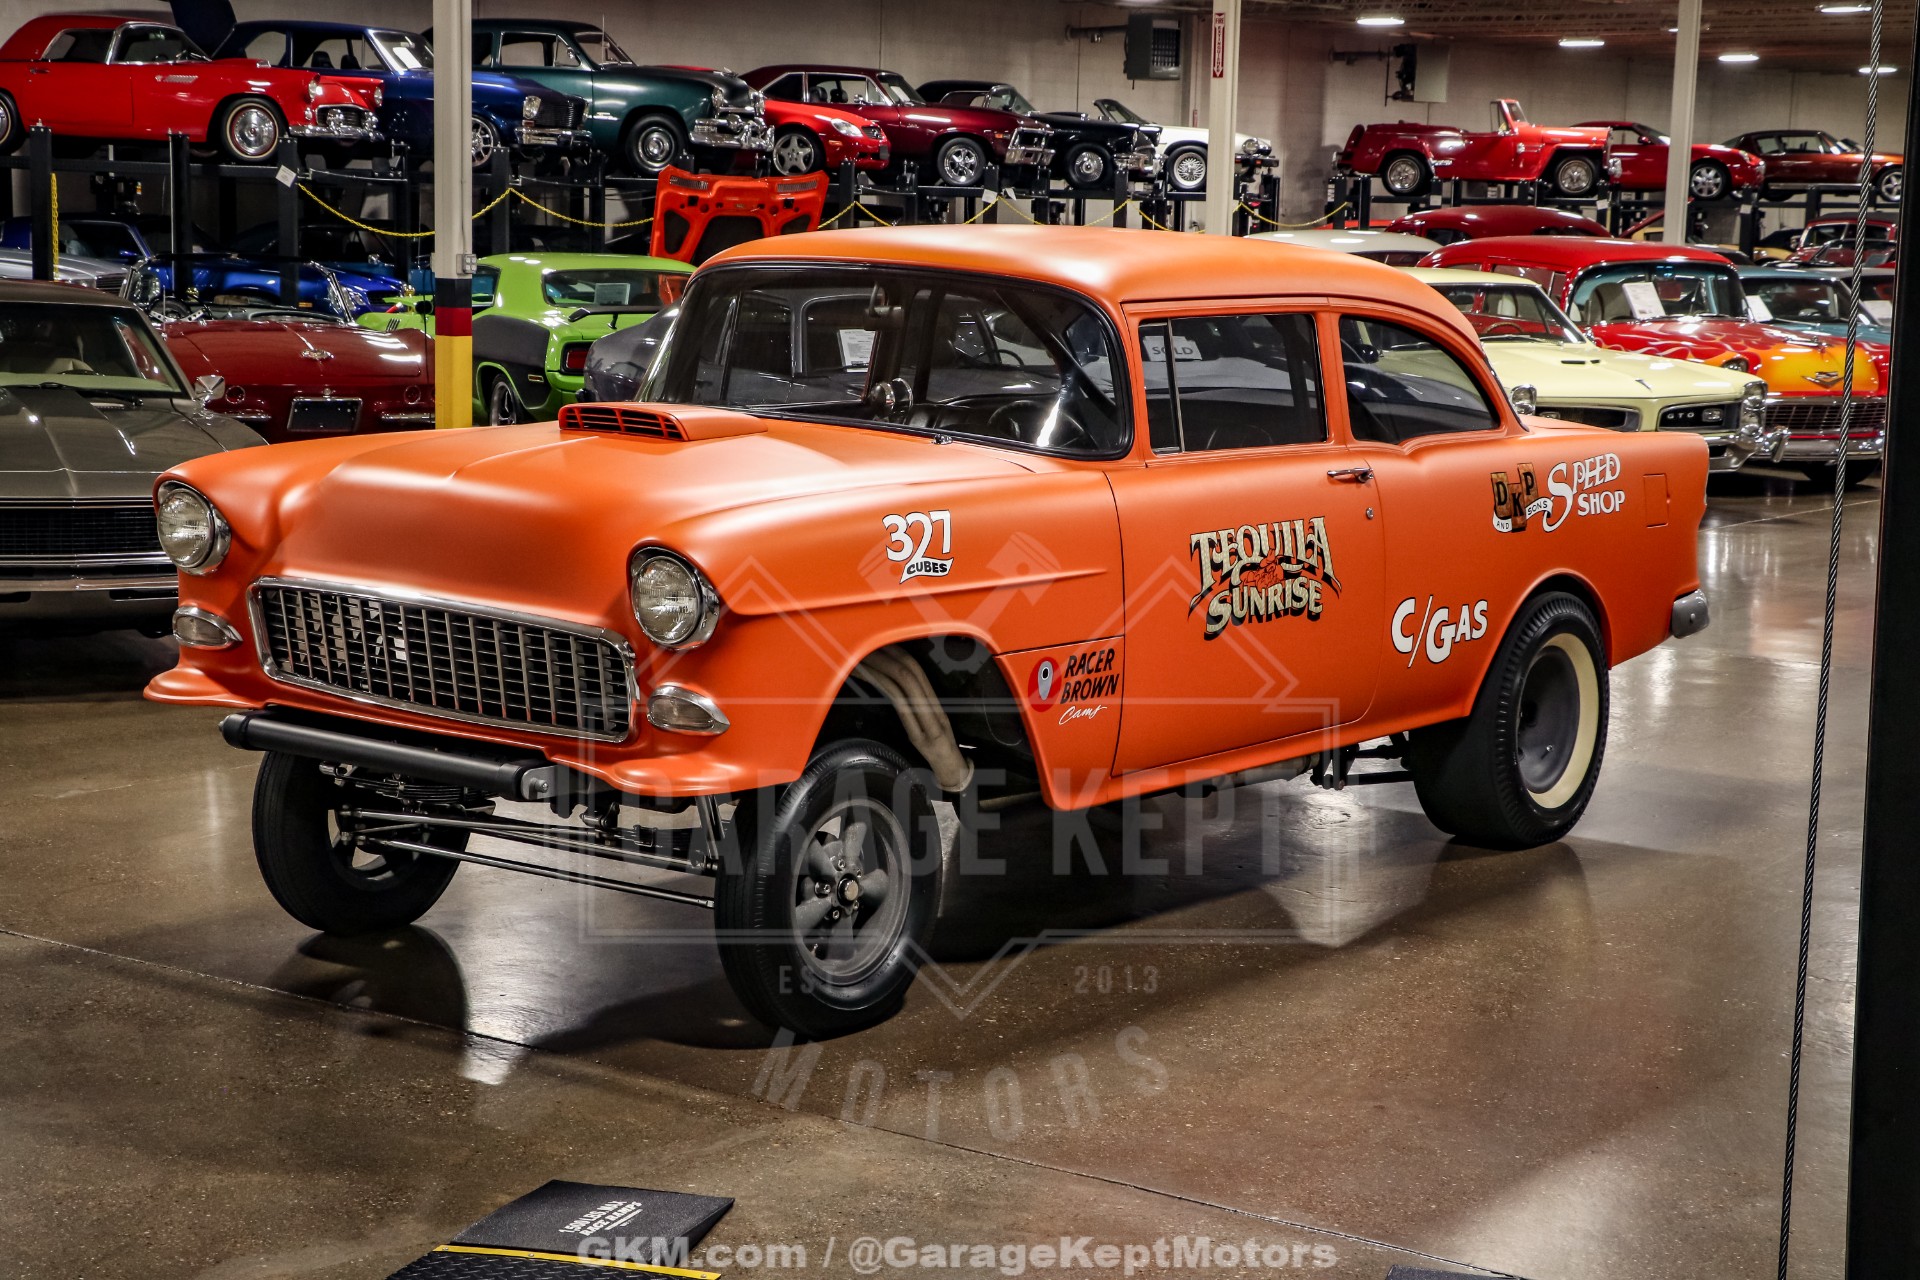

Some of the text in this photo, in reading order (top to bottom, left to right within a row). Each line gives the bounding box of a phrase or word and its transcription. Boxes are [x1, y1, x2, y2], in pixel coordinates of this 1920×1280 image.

[1667, 411, 1695, 419] GTO
[1543, 452, 1621, 532] SPEED
[1577, 489, 1625, 516] SHOP
[1496, 500, 1548, 530] AND SONS
[882, 509, 953, 585] 327
[906, 561, 948, 575] CUBES
[1188, 516, 1342, 616] TEQUILA
[1204, 576, 1323, 640] SUNRISE
[1391, 594, 1488, 669] C/GAS
[1064, 648, 1115, 678] RACER
[1060, 674, 1120, 704] BROWN
[1058, 704, 1107, 725] Cams
[579, 1201, 642, 1236] RACE RAMPS
